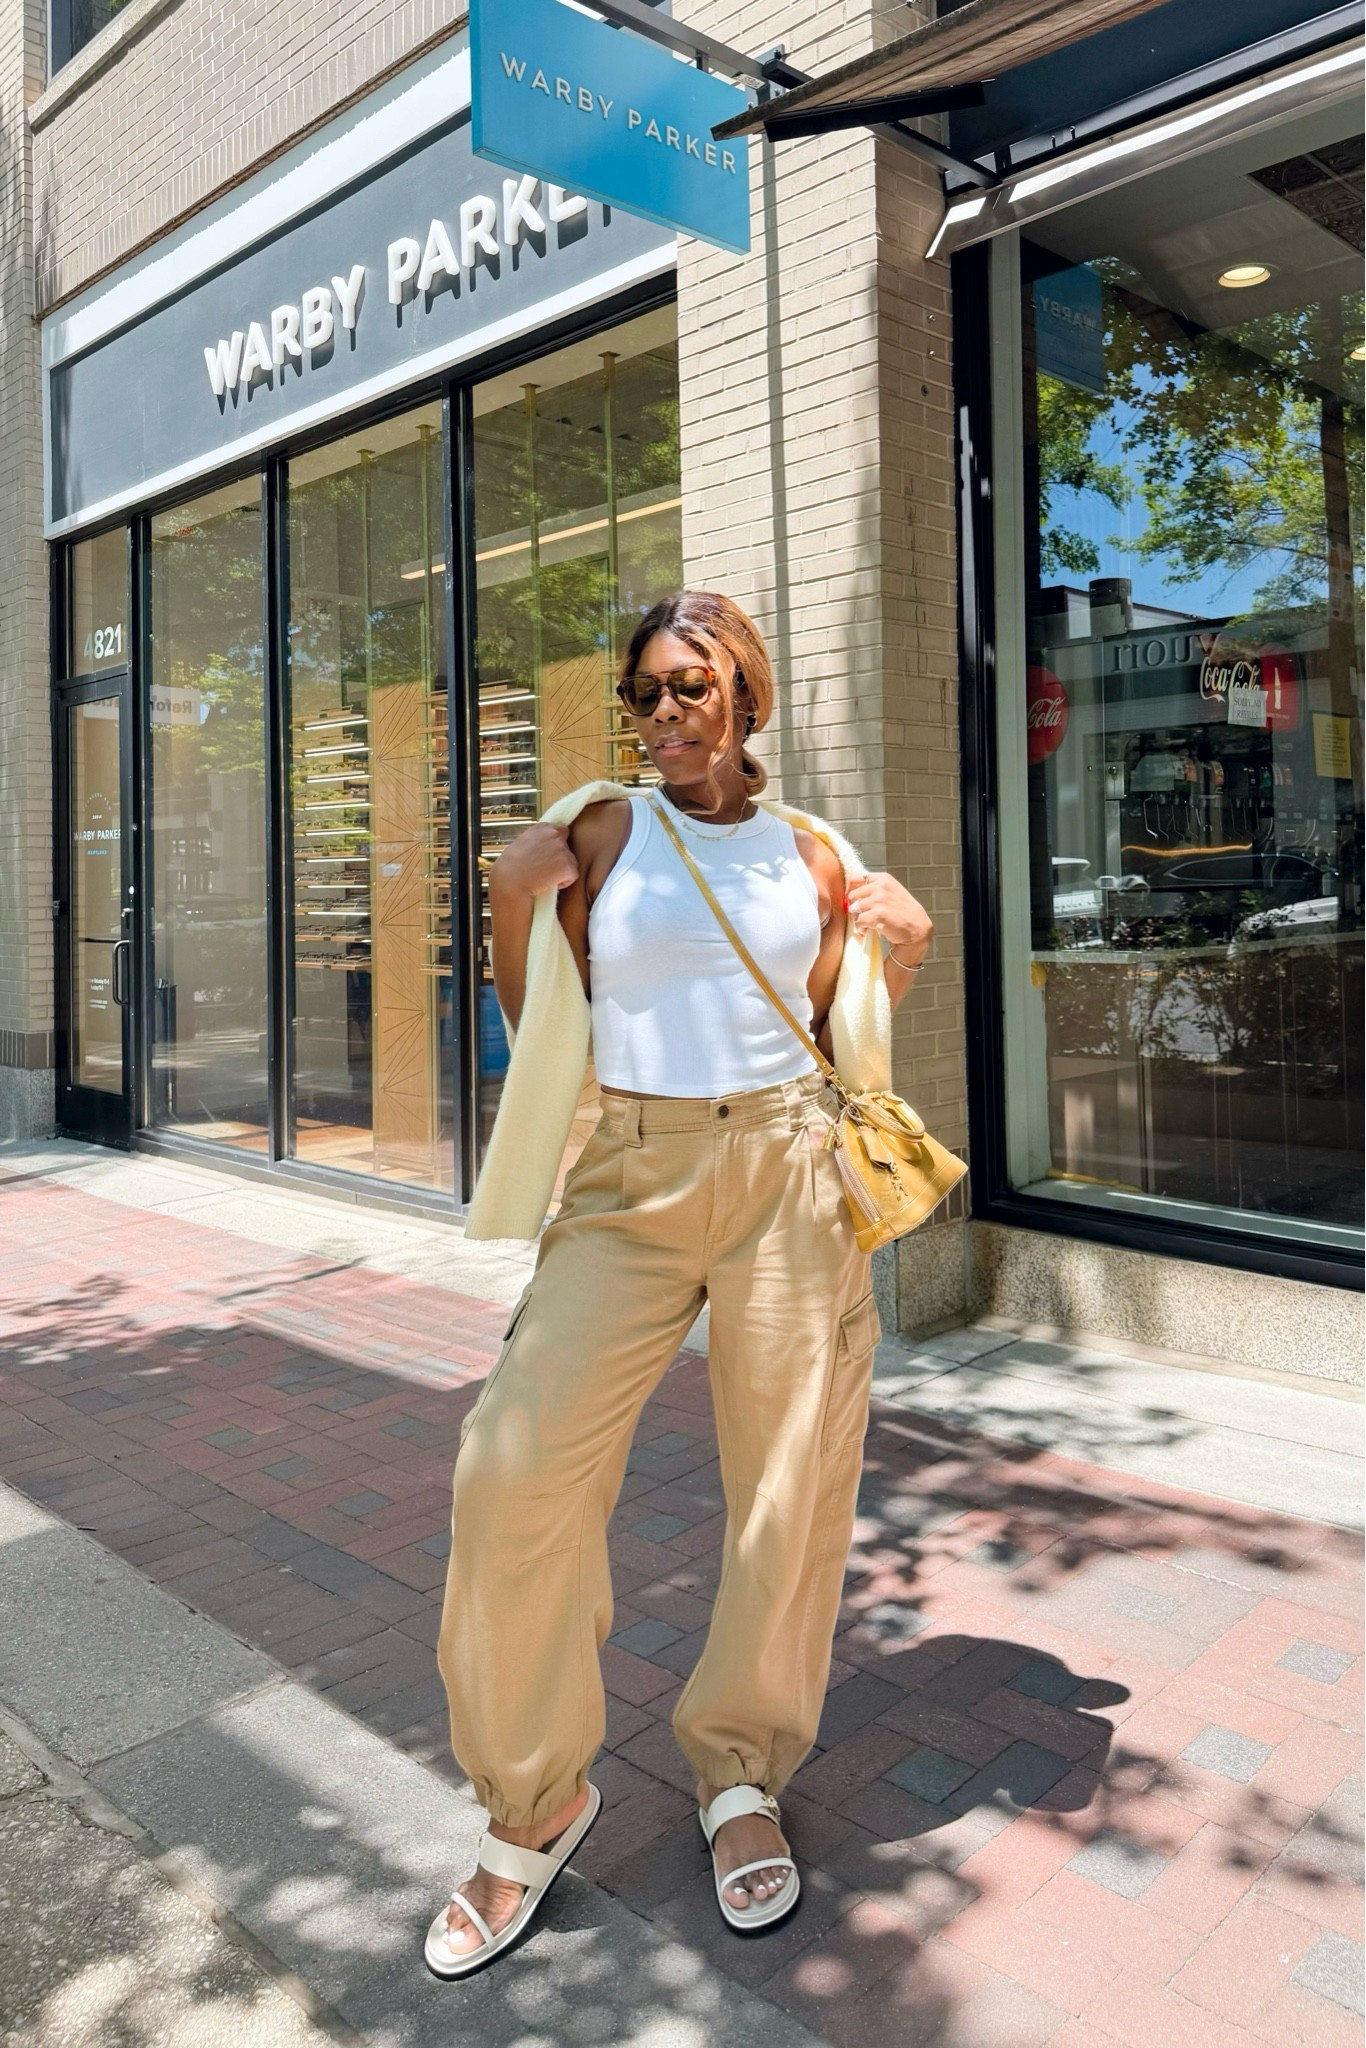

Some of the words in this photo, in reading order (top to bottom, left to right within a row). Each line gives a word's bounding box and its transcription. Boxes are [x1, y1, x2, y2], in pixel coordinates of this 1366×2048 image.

[499, 52, 614, 119] WARBY
[627, 108, 737, 175] PARKER
[203, 264, 365, 396] WARBY
[387, 173, 588, 305] PARK
[83, 623, 122, 662] 4821
[1199, 656, 1261, 704] Coca-Cl
[73, 830, 96, 841] WARBY
